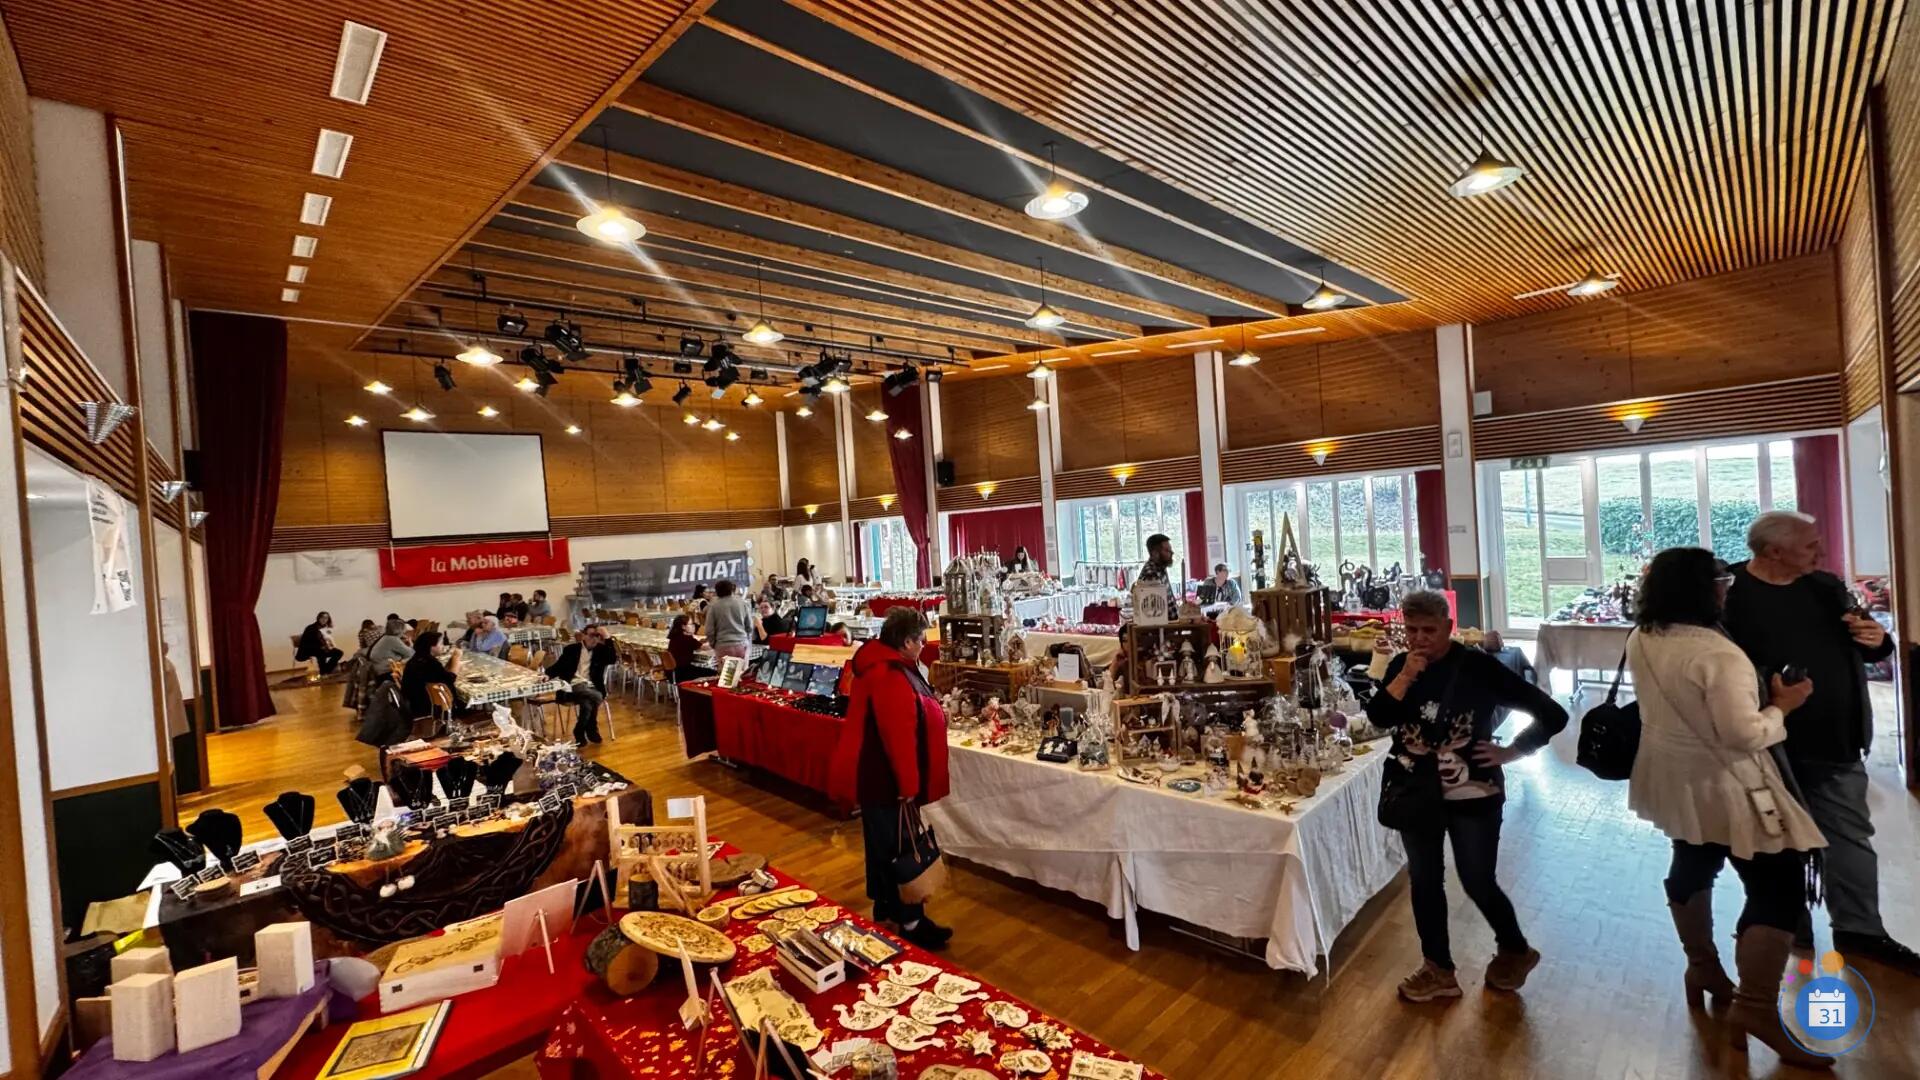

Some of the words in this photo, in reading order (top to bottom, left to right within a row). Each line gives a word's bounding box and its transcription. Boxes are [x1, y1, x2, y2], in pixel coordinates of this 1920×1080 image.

[430, 557, 446, 573] la
[450, 554, 529, 572] Mobilière
[668, 558, 742, 584] LIMAT
